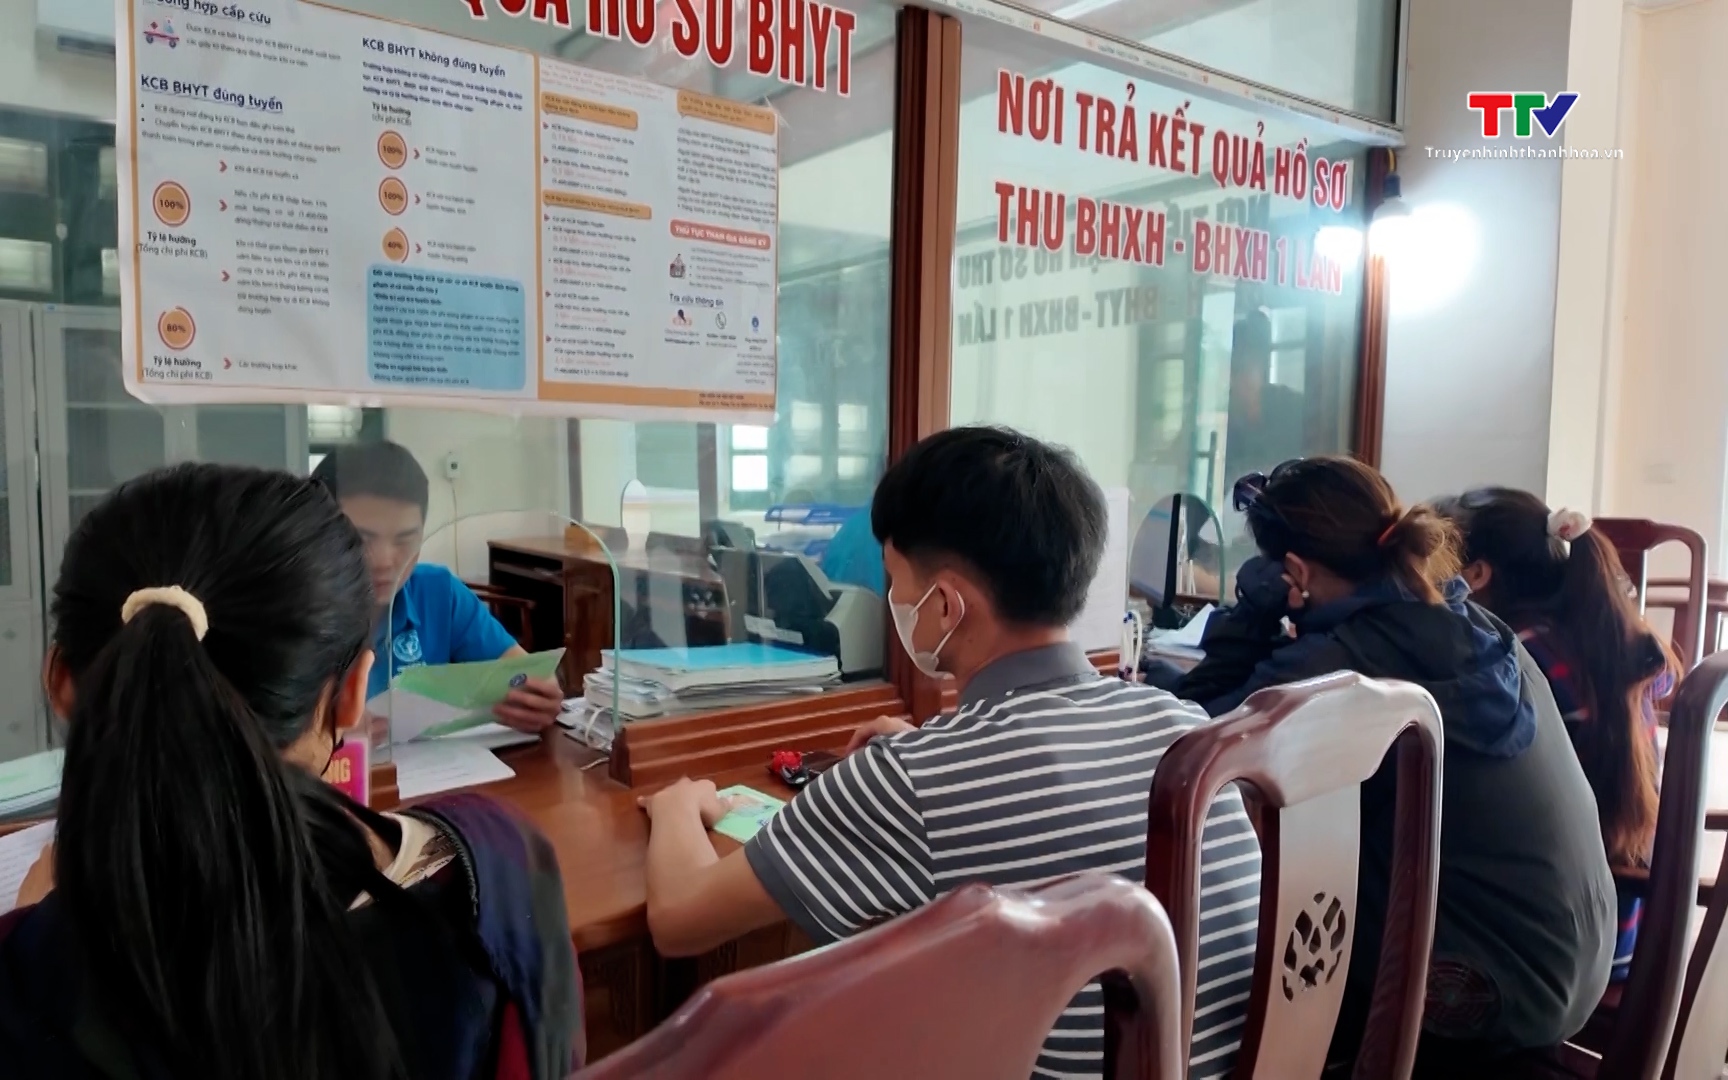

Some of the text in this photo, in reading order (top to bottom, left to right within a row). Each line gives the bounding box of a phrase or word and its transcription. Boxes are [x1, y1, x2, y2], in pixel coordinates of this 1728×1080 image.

[222, 3, 245, 19] cấp
[249, 9, 271, 24] cứu
[362, 37, 384, 52] KCB
[387, 42, 415, 58] BHYT
[419, 49, 450, 67] không
[452, 56, 477, 73] đúng
[748, 0, 856, 96] BHYT
[141, 74, 168, 91] KCB
[173, 80, 209, 97] BHYT
[213, 88, 244, 107] đúng
[998, 69, 1065, 145] NƠI
[1076, 81, 1138, 162] TRẢ
[1149, 99, 1206, 176] KẾT
[1212, 121, 1266, 191] QUẢ
[1274, 137, 1309, 200] HỒ
[1314, 158, 1349, 210] SƠ
[159, 199, 184, 210] 100%
[995, 181, 1065, 251] THU
[1075, 196, 1166, 267] BHXH
[1174, 239, 1185, 253] -
[1194, 220, 1270, 281] BHXH
[1276, 237, 1287, 285] 1
[161, 245, 173, 256] chi
[166, 323, 187, 333] 80%
